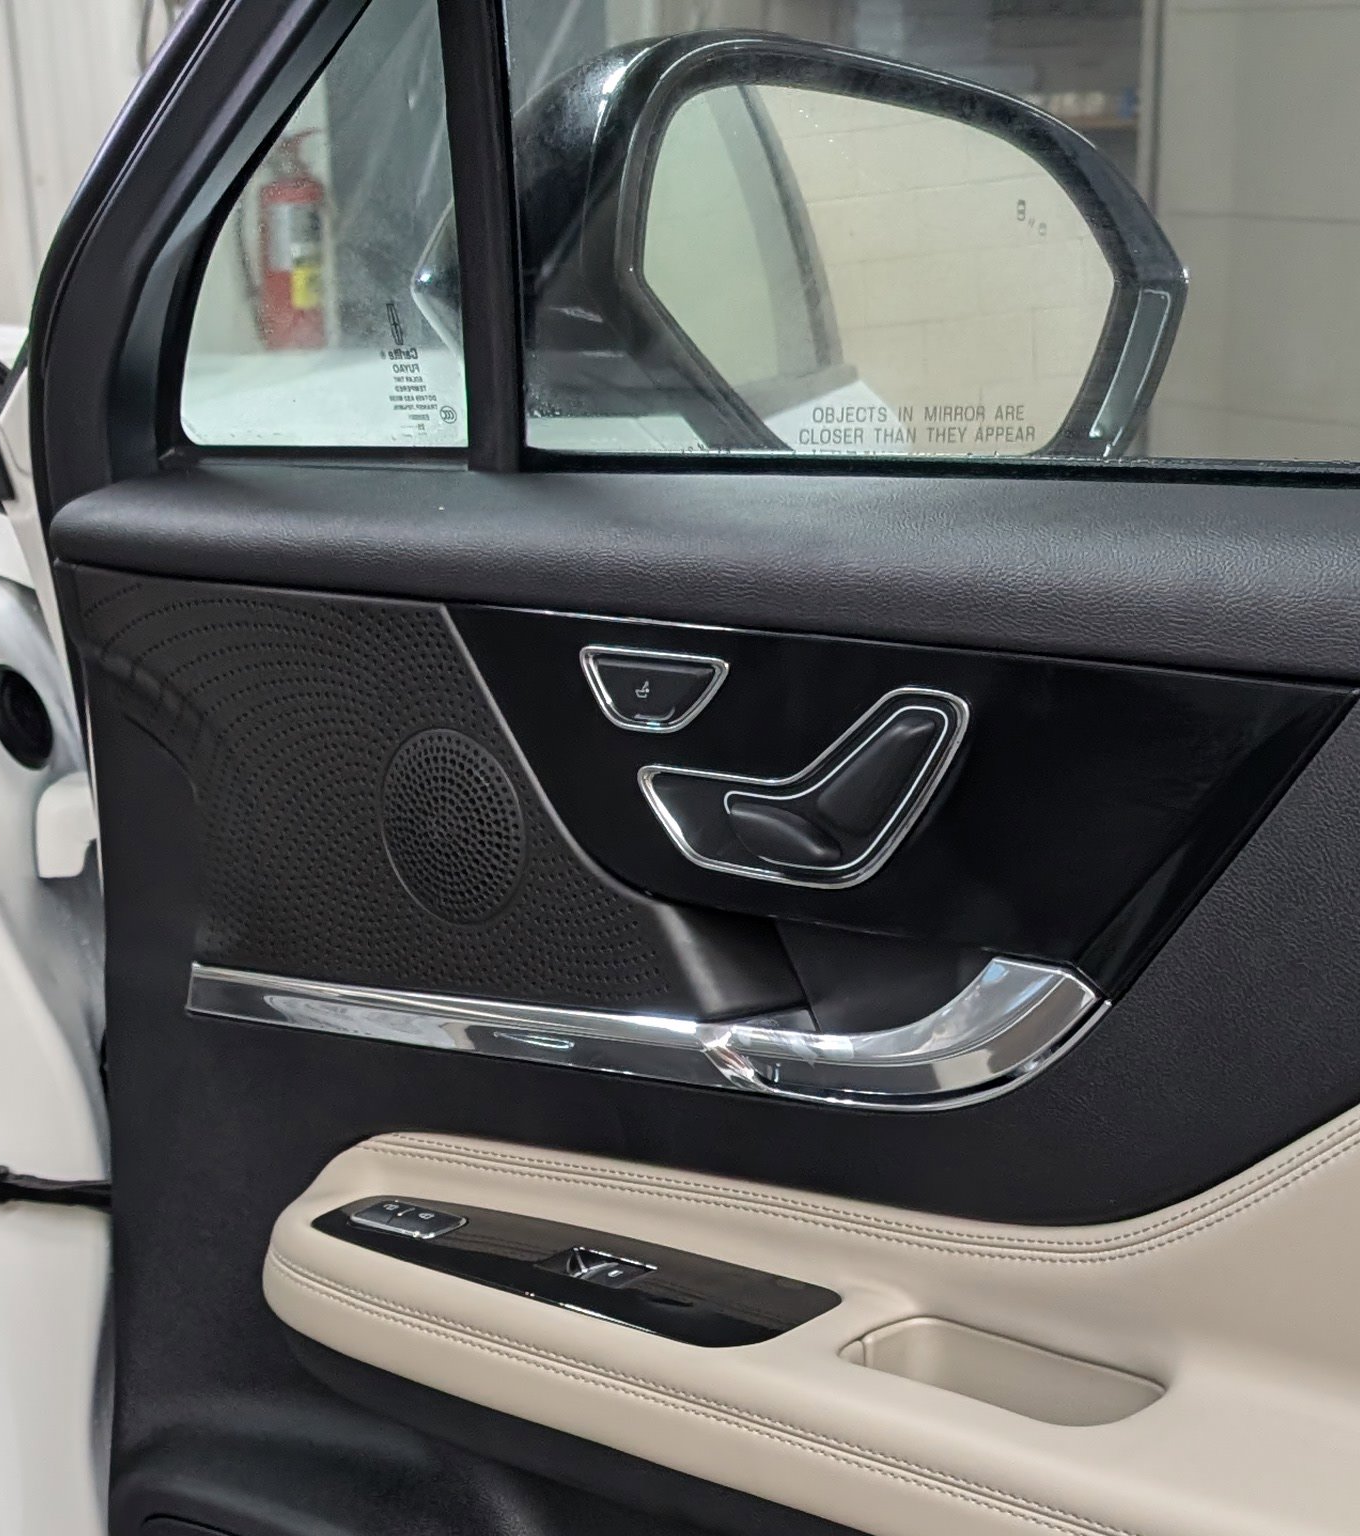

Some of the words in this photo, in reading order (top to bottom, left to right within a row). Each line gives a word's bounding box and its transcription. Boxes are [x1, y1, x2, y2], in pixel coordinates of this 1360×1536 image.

[812, 406, 888, 424] OBJECTS
[898, 406, 914, 422] IN
[924, 405, 985, 422] MIRROR
[995, 405, 1025, 421] ARE
[799, 428, 864, 445] CLOSER
[875, 428, 916, 444] THAN
[928, 427, 968, 443] THEY
[975, 426, 1036, 443] APPEAR
